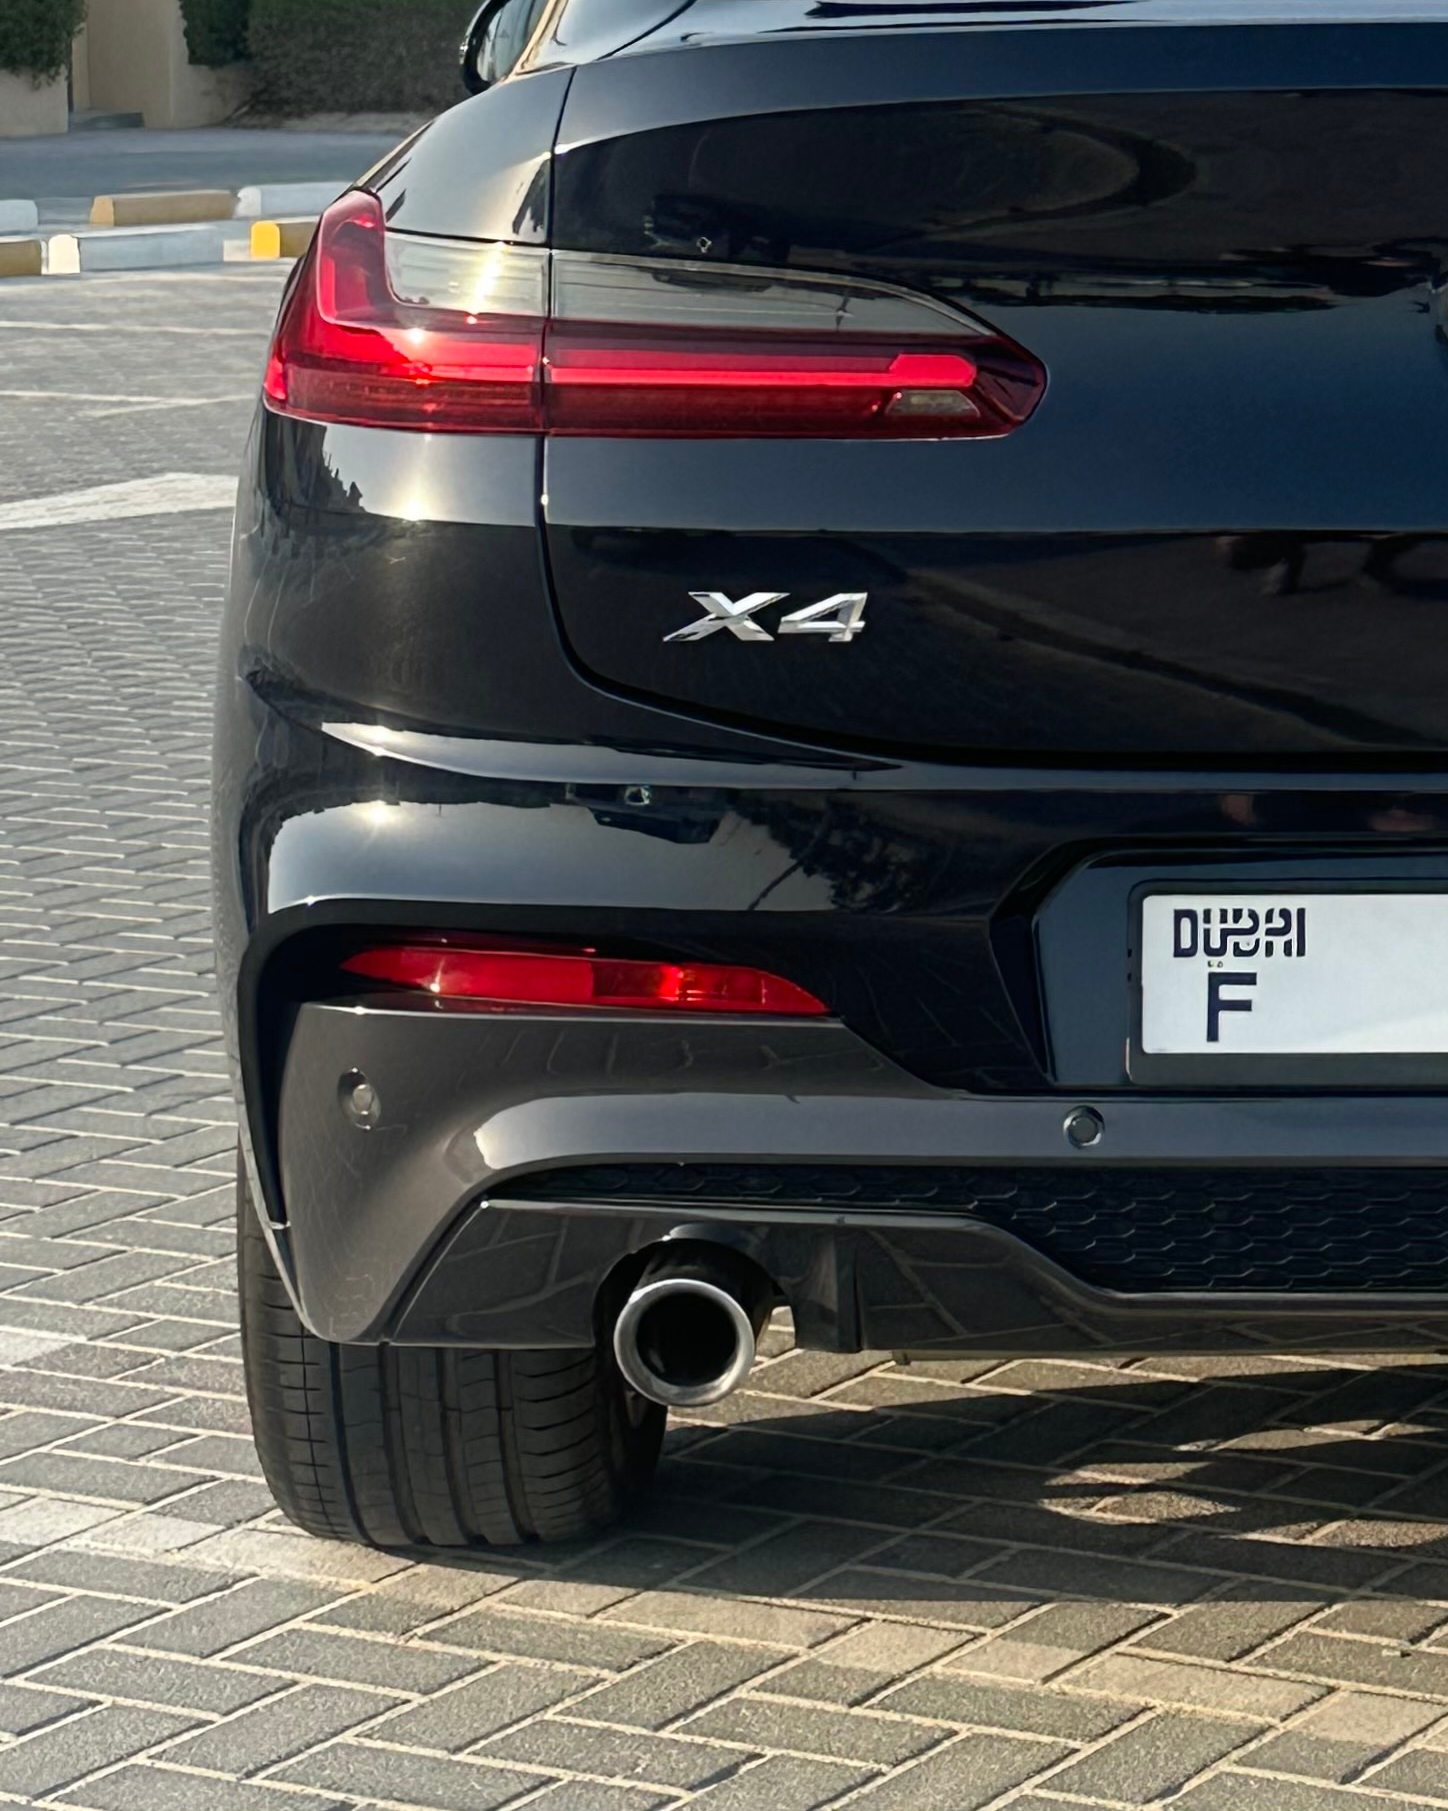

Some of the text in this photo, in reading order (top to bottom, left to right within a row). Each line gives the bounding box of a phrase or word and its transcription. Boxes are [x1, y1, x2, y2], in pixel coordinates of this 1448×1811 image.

[662, 591, 869, 642] X4
[1173, 907, 1307, 958] DUBAI
[1206, 971, 1257, 1043] F
